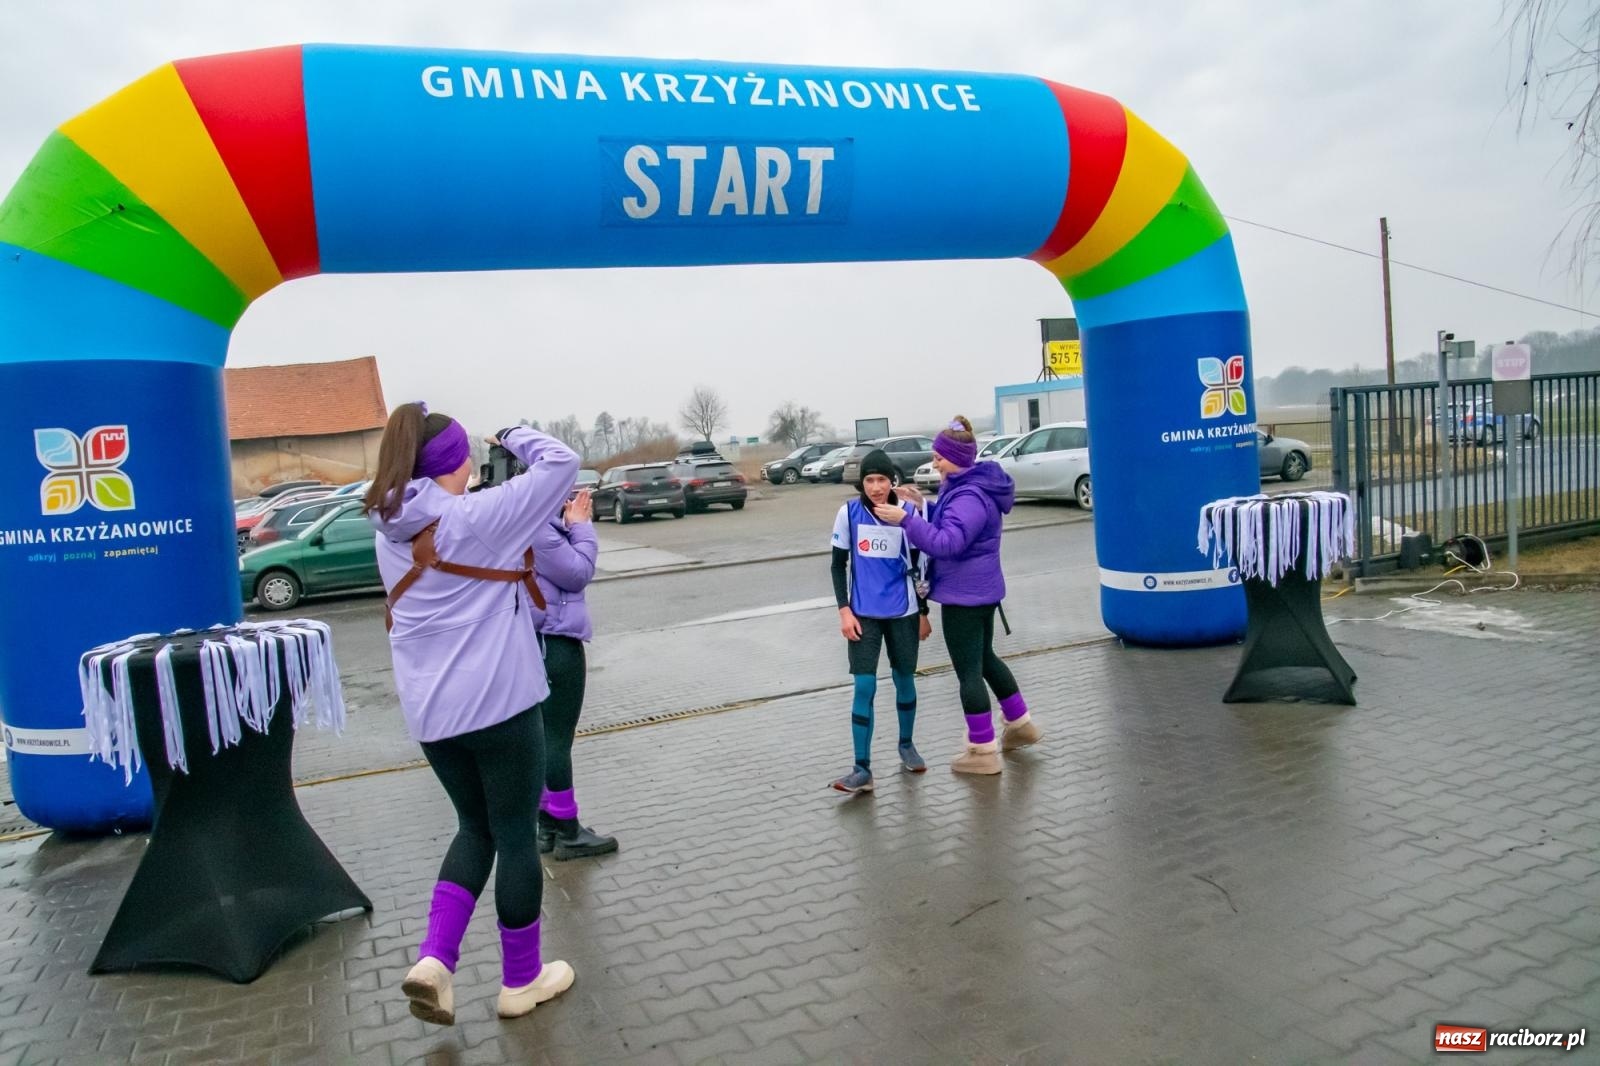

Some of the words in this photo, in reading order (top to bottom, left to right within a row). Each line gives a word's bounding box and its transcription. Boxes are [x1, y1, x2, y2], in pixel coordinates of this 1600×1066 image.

[420, 65, 608, 101] GMINA
[620, 71, 981, 112] KRZYŻANOWICE
[622, 144, 835, 220] START
[1051, 352, 1070, 364] 575
[1073, 351, 1082, 364] 7
[1496, 358, 1526, 368] STOP
[1161, 428, 1204, 443] GMINA
[51, 518, 193, 543] KRZYŻANOWICE
[871, 538, 888, 551] 66
[28, 551, 56, 563] odkryj
[63, 550, 96, 561] poznaj
[104, 545, 159, 559] zapamiętaj
